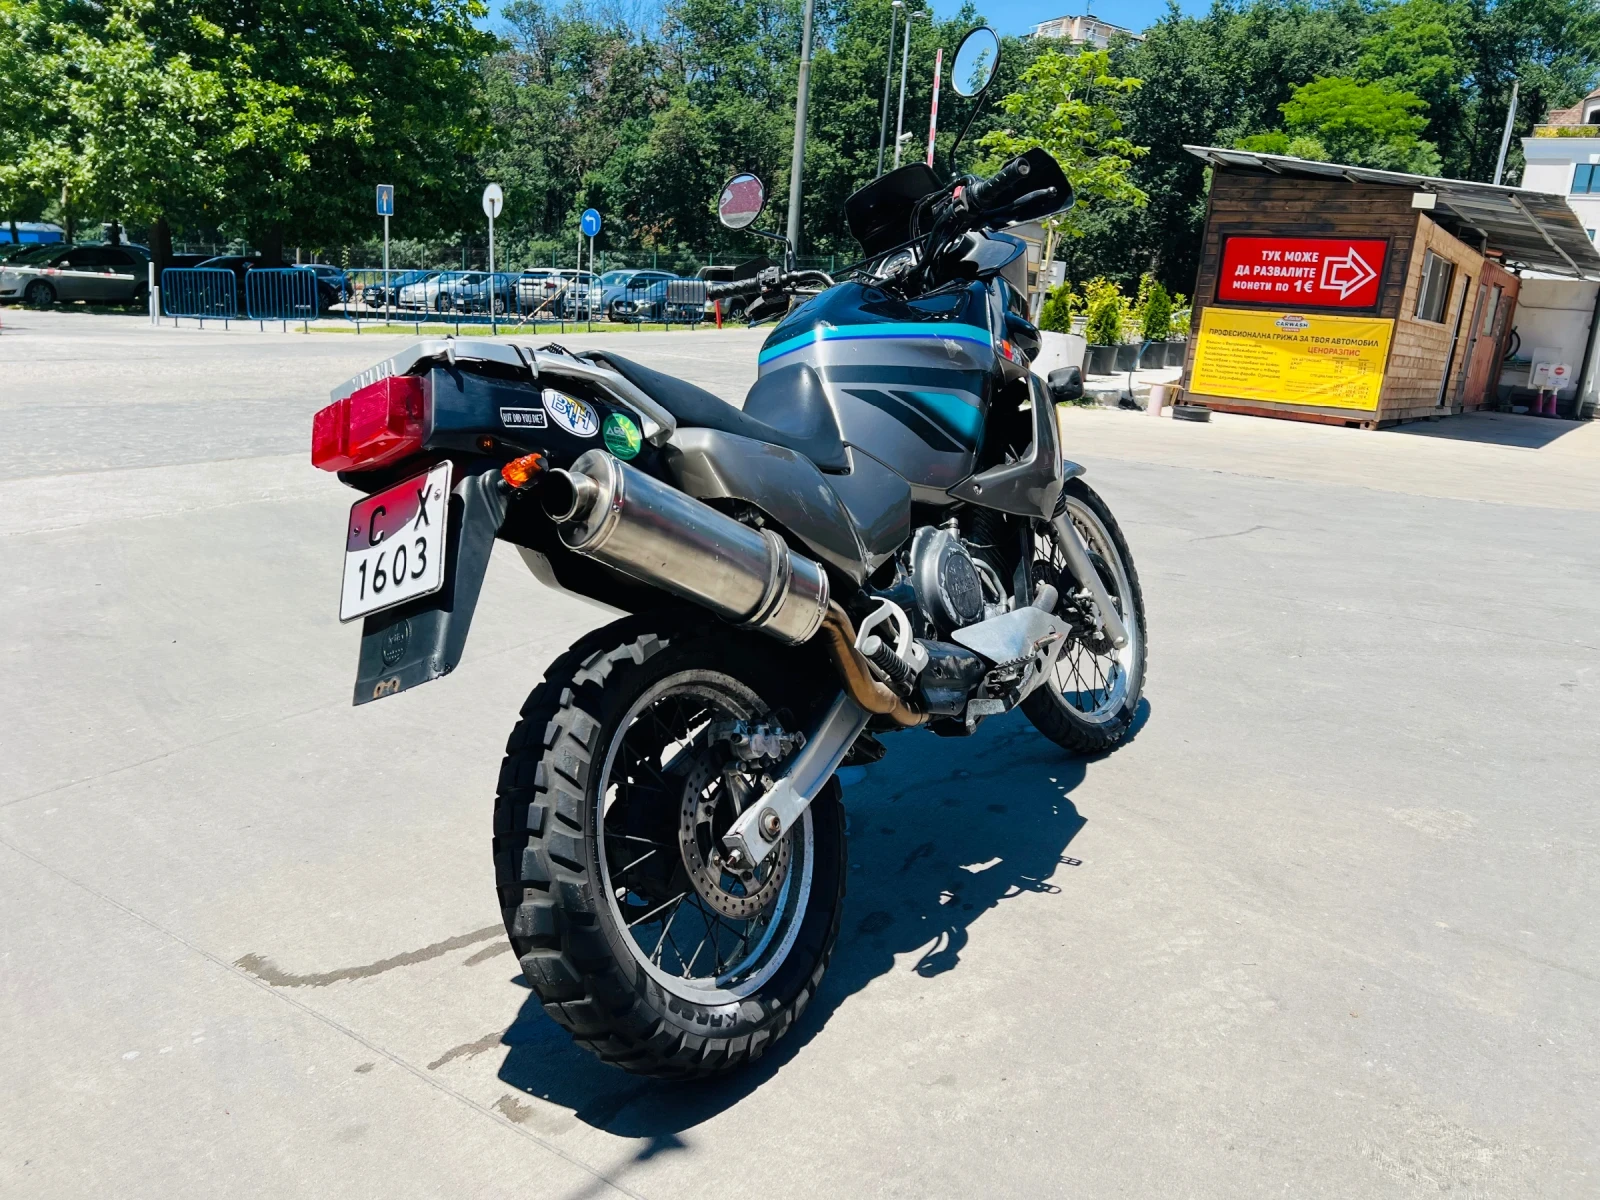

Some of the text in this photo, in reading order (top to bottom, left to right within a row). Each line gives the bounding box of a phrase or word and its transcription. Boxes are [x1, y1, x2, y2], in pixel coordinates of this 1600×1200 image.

[1261, 250, 1319, 263] ТУК МОЖЕ
[1234, 265, 1316, 278] ДА РАЗВАЛИТЕ
[1275, 282, 1289, 292] по
[1293, 280, 1313, 293] 1€
[1209, 328, 1271, 340] ПРОФЕСИОНАЛНА
[1272, 333, 1298, 342] ГРИЖА
[1310, 336, 1330, 344] ТВОЯ
[1331, 337, 1379, 347] АВТОМОБИЛ
[1307, 346, 1361, 357] ЦЕНОРАЗПИС
[503, 412, 512, 423] BUT
[512, 413, 522, 423] DID
[358, 536, 428, 601] 1603
